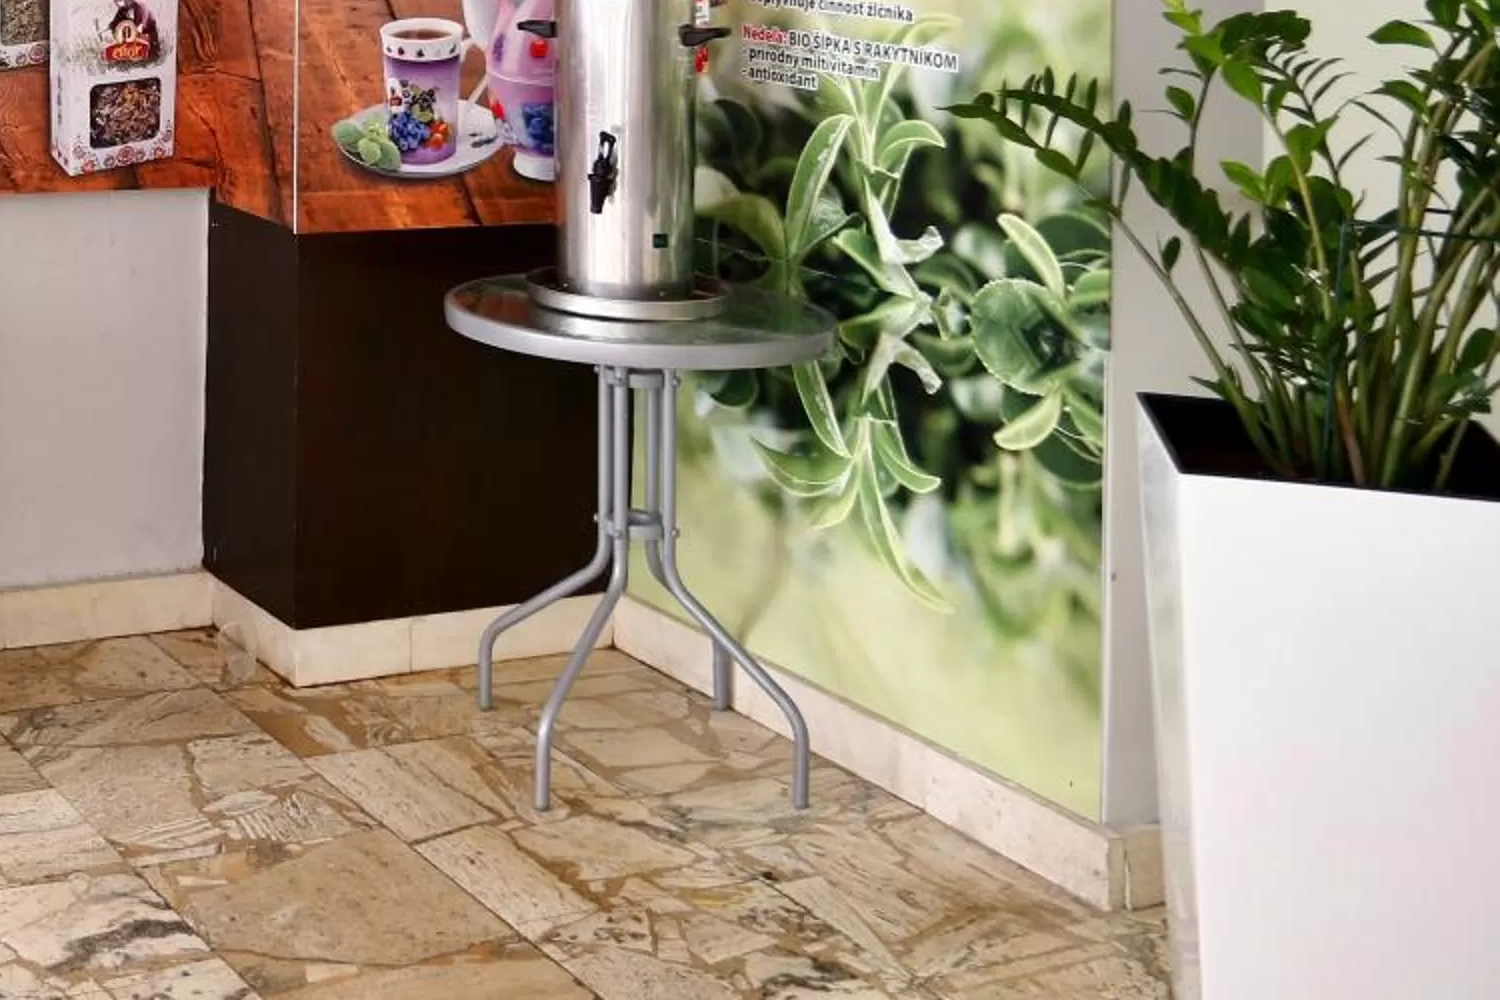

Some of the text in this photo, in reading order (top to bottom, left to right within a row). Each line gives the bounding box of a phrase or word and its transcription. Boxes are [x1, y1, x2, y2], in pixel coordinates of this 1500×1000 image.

[789, 30, 810, 47] BIO
[854, 41, 861, 55] S
[749, 67, 816, 88] antioxidant
